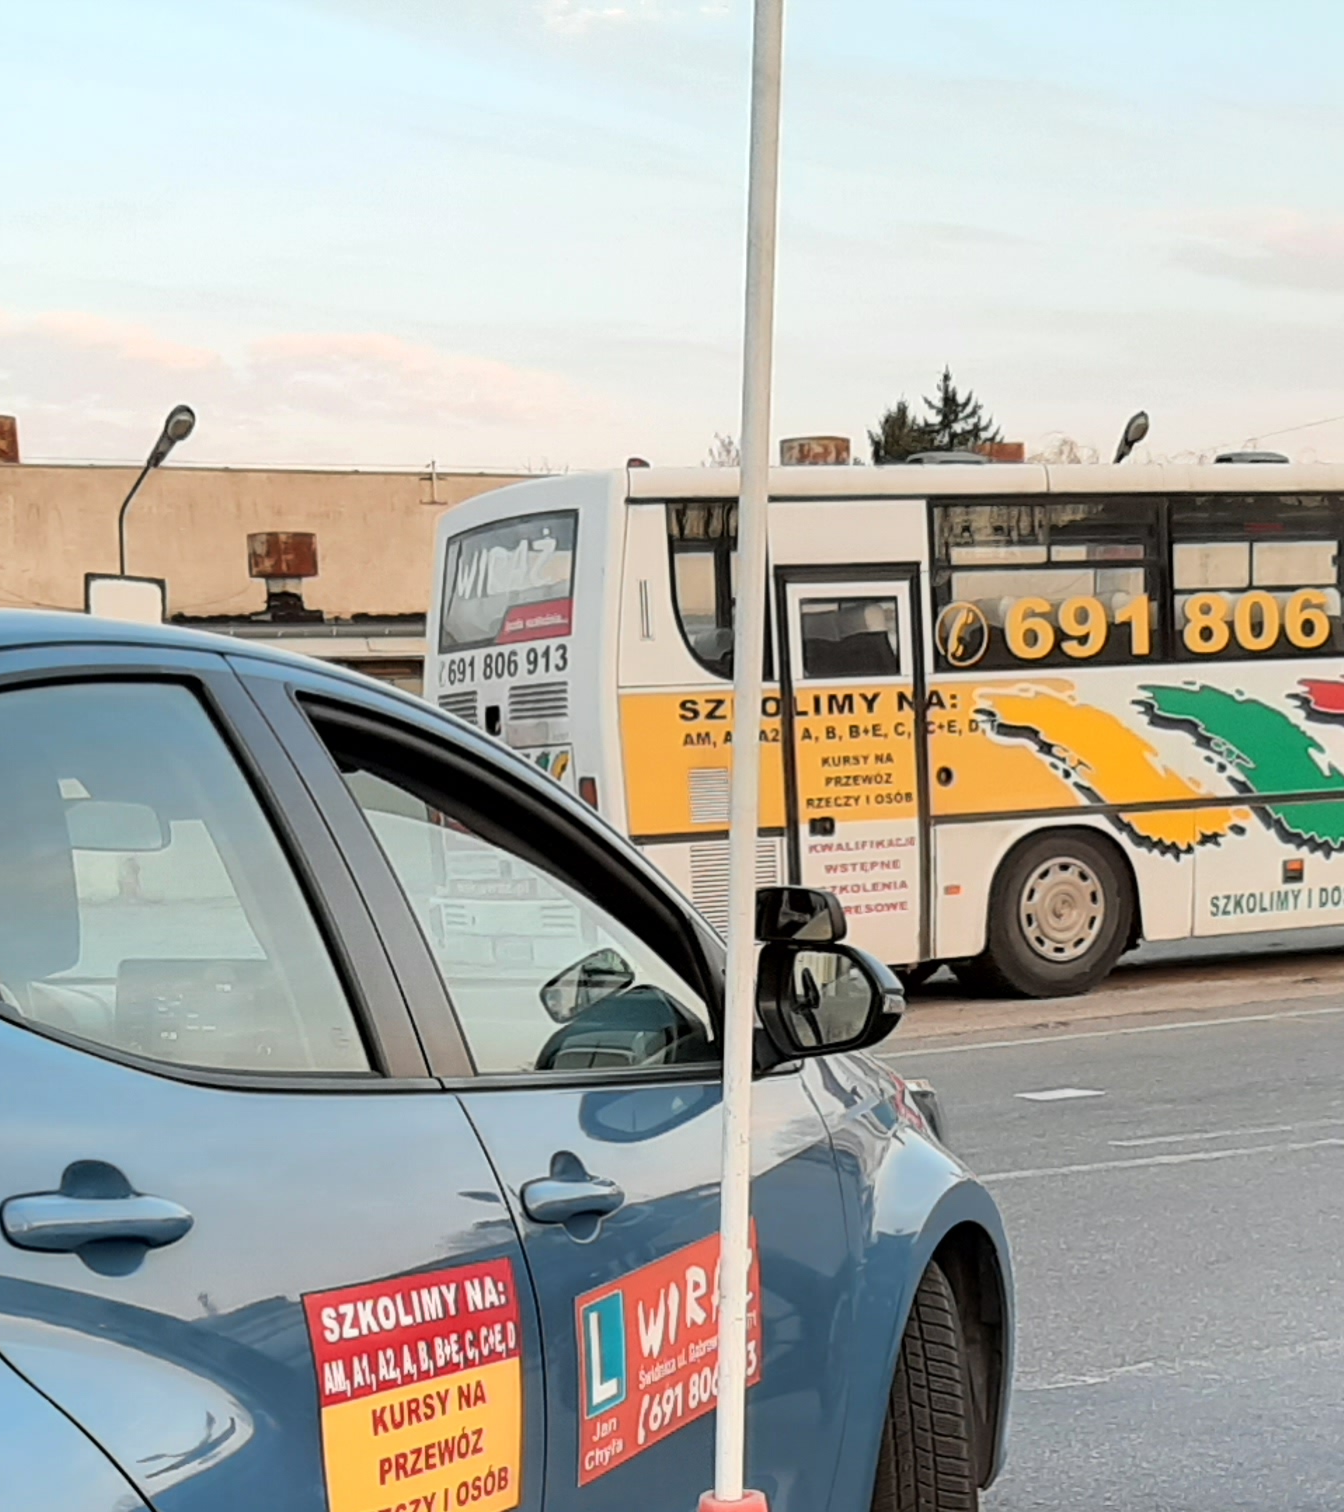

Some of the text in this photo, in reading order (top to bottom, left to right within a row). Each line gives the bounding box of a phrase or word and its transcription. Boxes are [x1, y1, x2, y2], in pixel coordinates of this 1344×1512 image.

[1006, 593, 1152, 660] 691
[1182, 588, 1332, 653] 806
[448, 643, 568, 686] 691 806 913
[678, 691, 881, 721] SZOLIMY
[683, 731, 717, 748] AM,
[801, 727, 819, 743] A,
[825, 726, 843, 742] B,
[849, 724, 889, 741] B+E,
[894, 722, 911, 739] C,
[821, 753, 894, 768] KURSY NA
[825, 772, 893, 787] PRZEWÓZ
[806, 791, 914, 809] RZECZY I OSÓB
[825, 859, 901, 875] WSTĘPNE
[820, 880, 908, 896] ZKOLENIA
[1210, 888, 1302, 917] SZKOLIMY
[1307, 888, 1313, 909] I
[321, 1276, 506, 1343] SZKOLIMY NA:
[323, 1320, 517, 1397] AM, A1, A2, A, B, B+E, C, C+E, D
[589, 1312, 618, 1407] L
[371, 1380, 487, 1437] KURSY NA
[649, 1381, 684, 1431] 691
[592, 1417, 618, 1442] Jan
[379, 1426, 484, 1485] PRZEWÓZ
[443, 1487, 449, 1512] I
[456, 1465, 509, 1507] OSÓB
